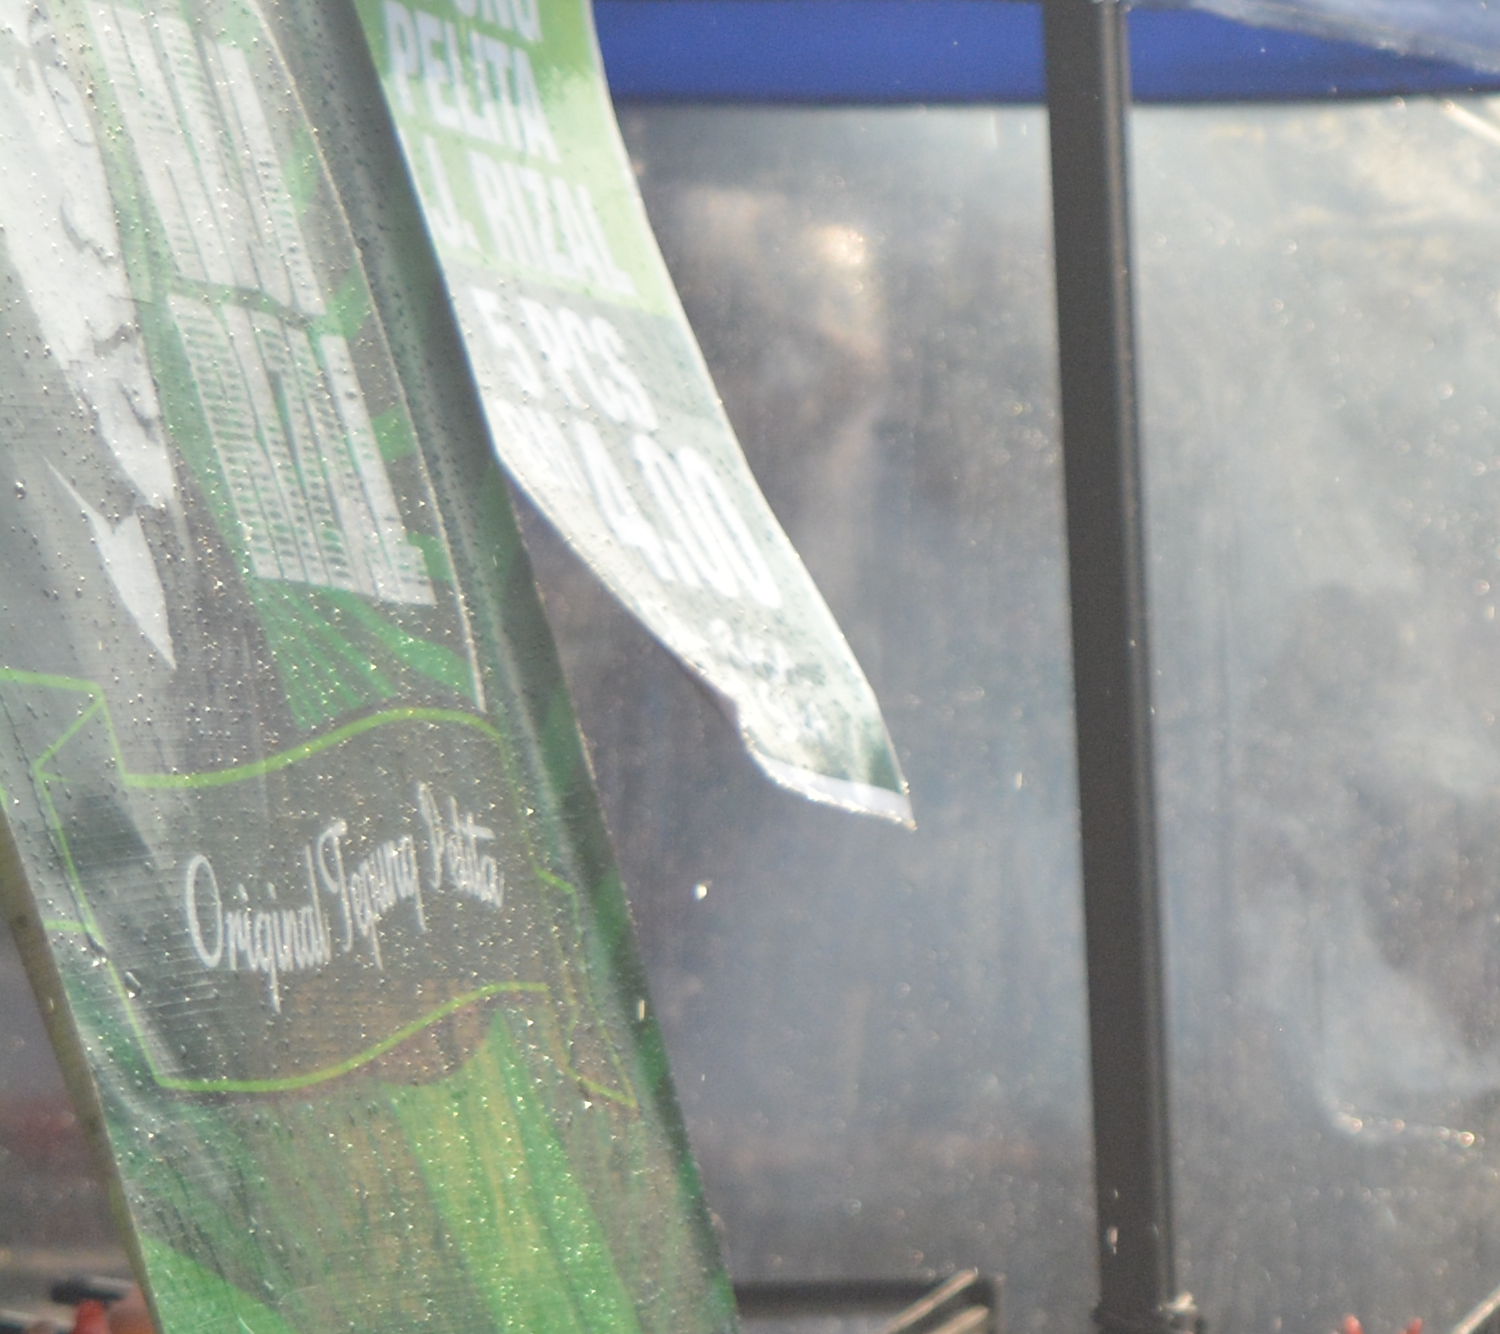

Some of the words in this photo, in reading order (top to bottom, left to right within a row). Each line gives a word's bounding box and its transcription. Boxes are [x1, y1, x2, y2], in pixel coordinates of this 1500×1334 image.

[466, 147, 641, 298] RIZAL
[470, 286, 546, 399] 5
[517, 296, 659, 431] PCS
[185, 843, 332, 1014] Original
[317, 818, 428, 970] Tepung
[417, 781, 506, 909] Pelita
